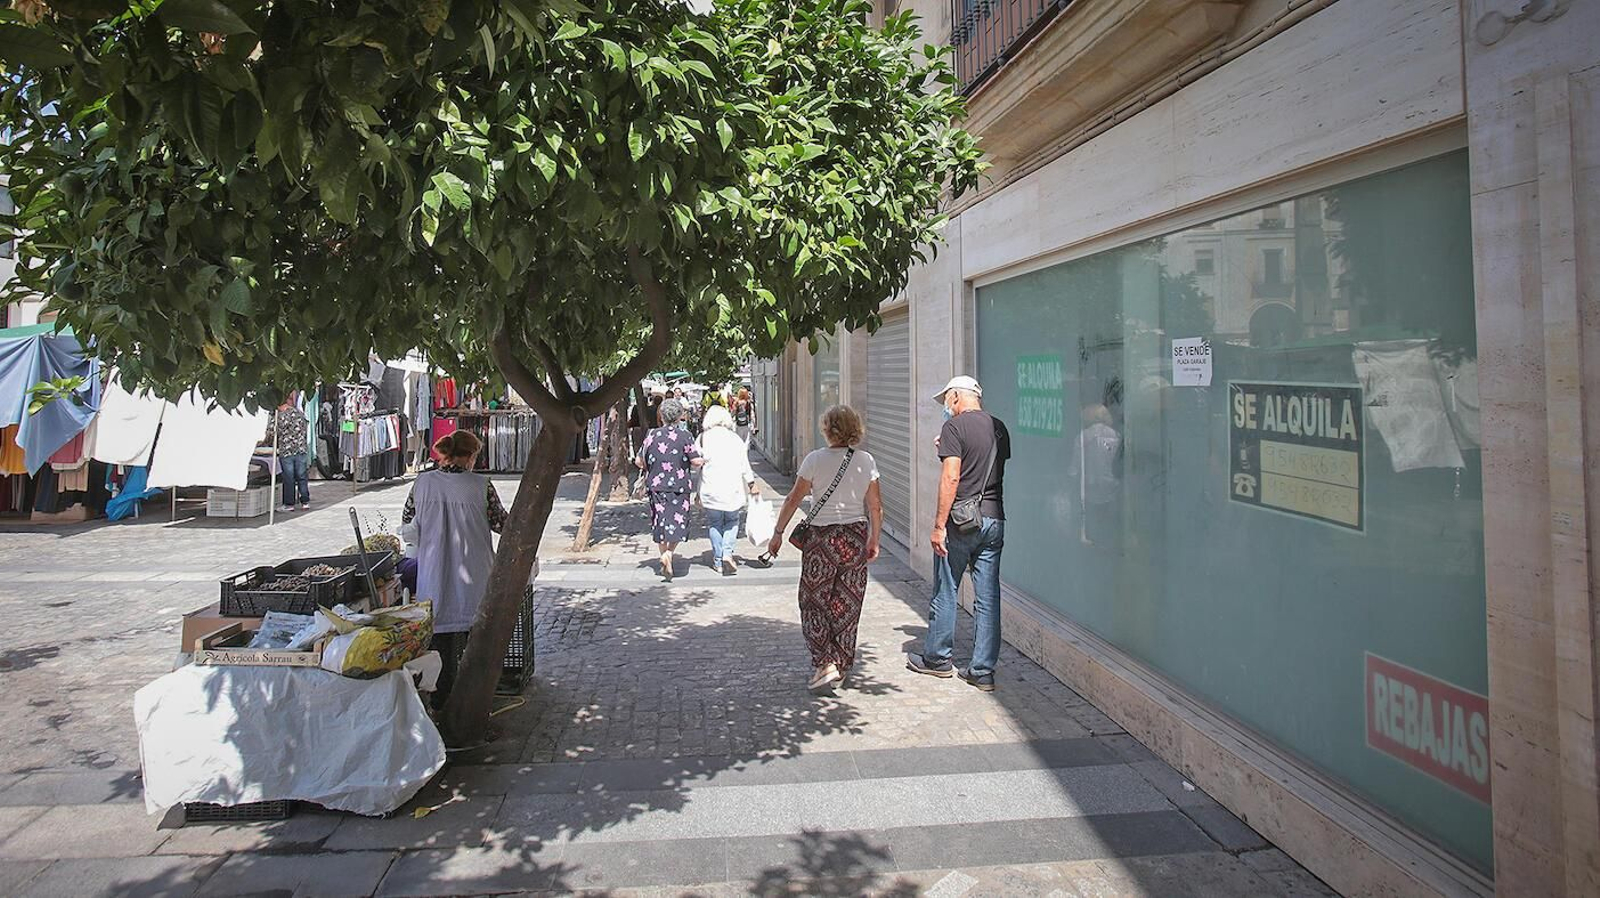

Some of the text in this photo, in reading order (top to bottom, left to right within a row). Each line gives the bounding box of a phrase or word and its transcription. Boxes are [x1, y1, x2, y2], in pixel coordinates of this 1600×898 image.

[1174, 345, 1210, 356] SE VENDE
[1017, 361, 1062, 390] SE ALQUILA
[1234, 392, 1357, 441] SE ALQUILA
[1373, 672, 1489, 784] REBAJAS
